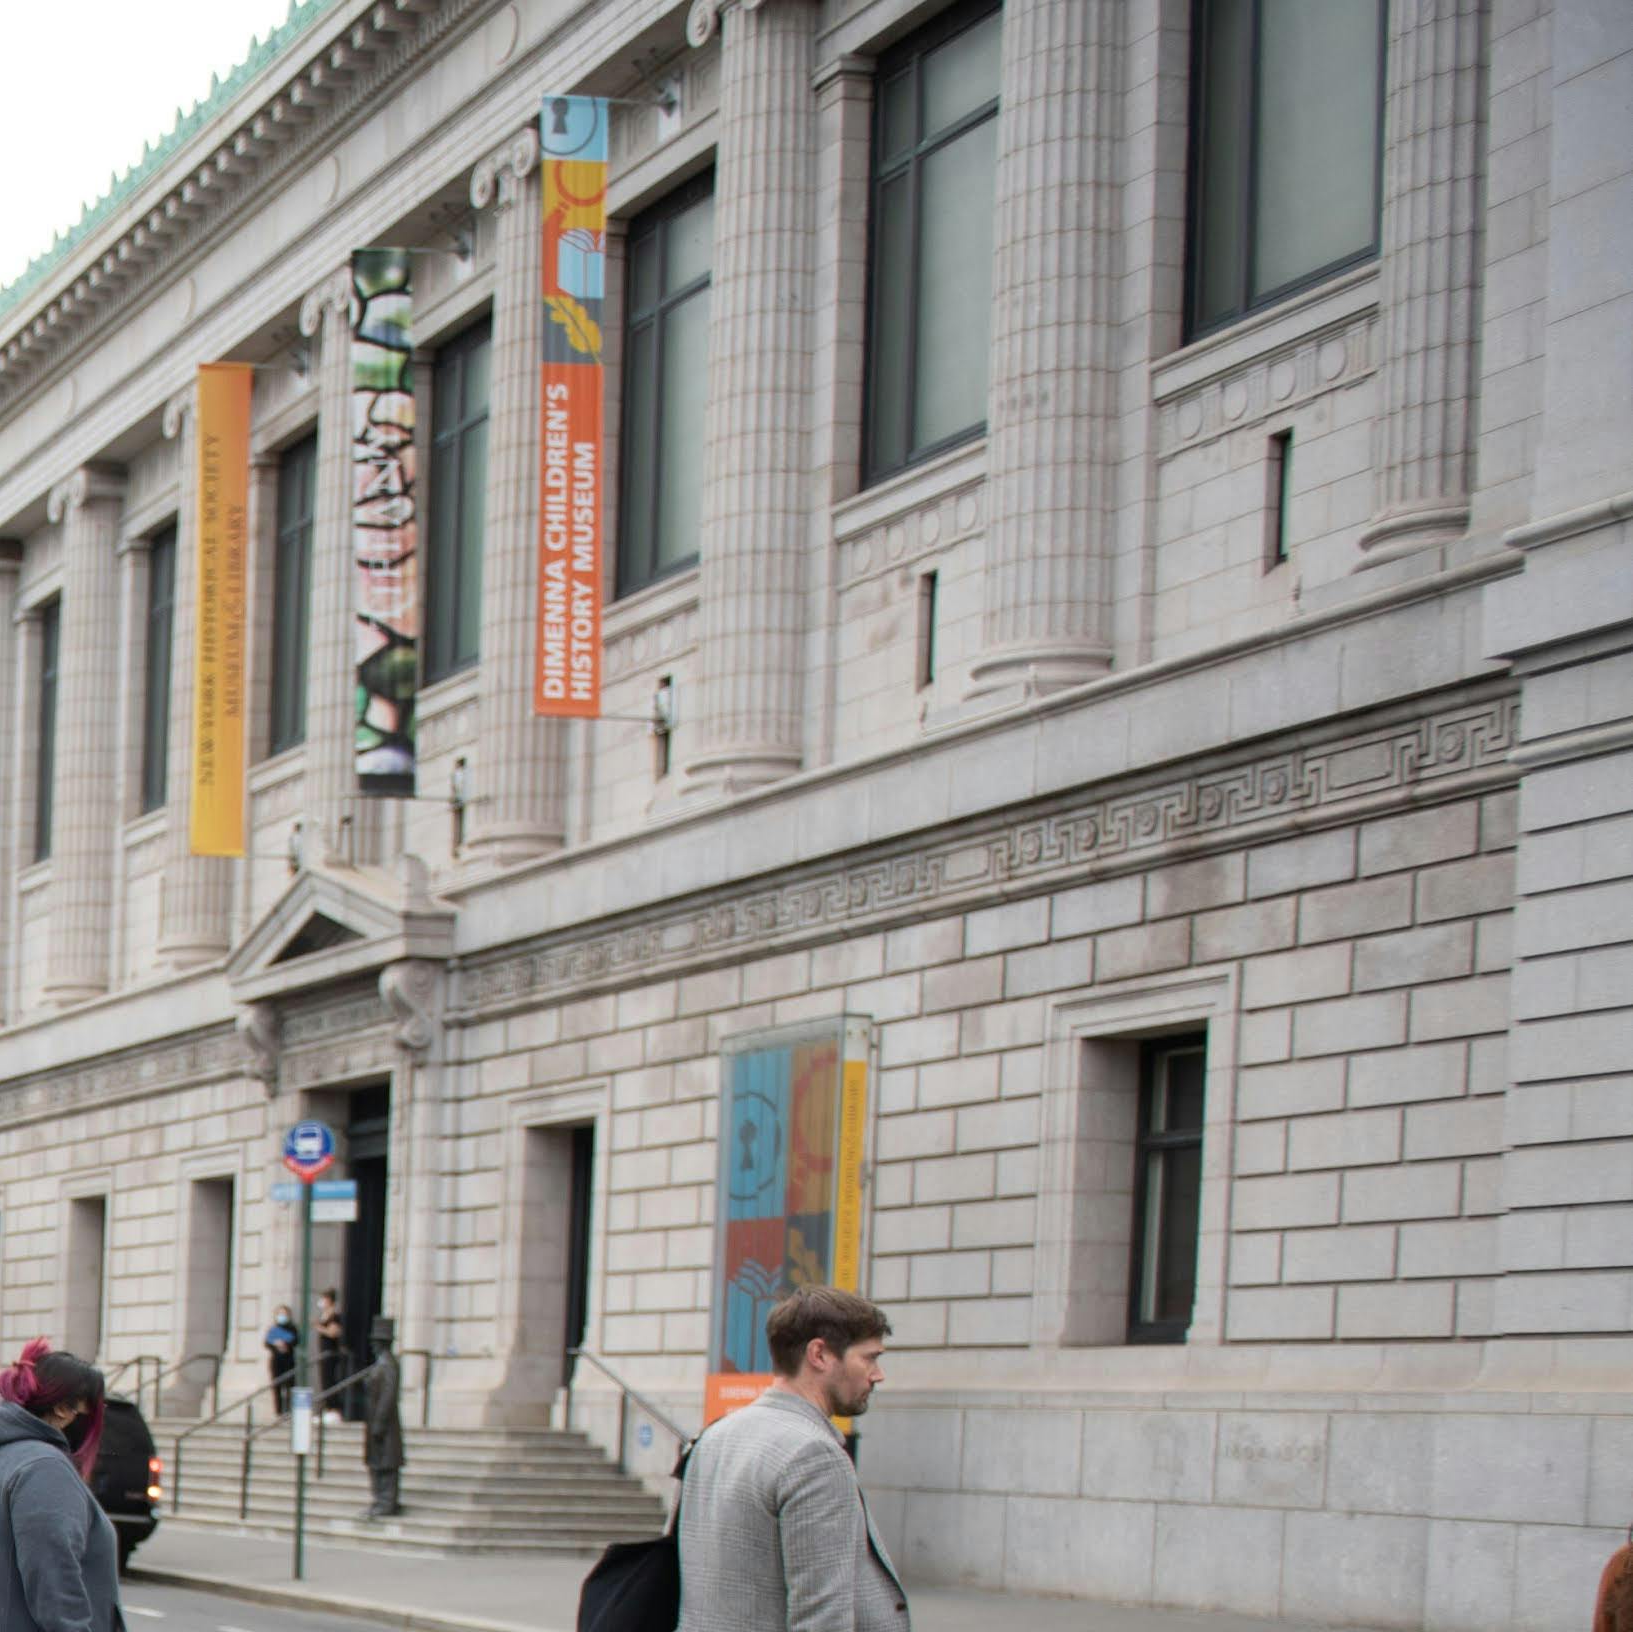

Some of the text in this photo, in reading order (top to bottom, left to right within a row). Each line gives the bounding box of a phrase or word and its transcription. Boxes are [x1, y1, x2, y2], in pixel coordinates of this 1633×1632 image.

[543, 383, 569, 700] DIMENNA CHILDREN'S
[571, 441, 596, 701] HISTORY MUSEUM
